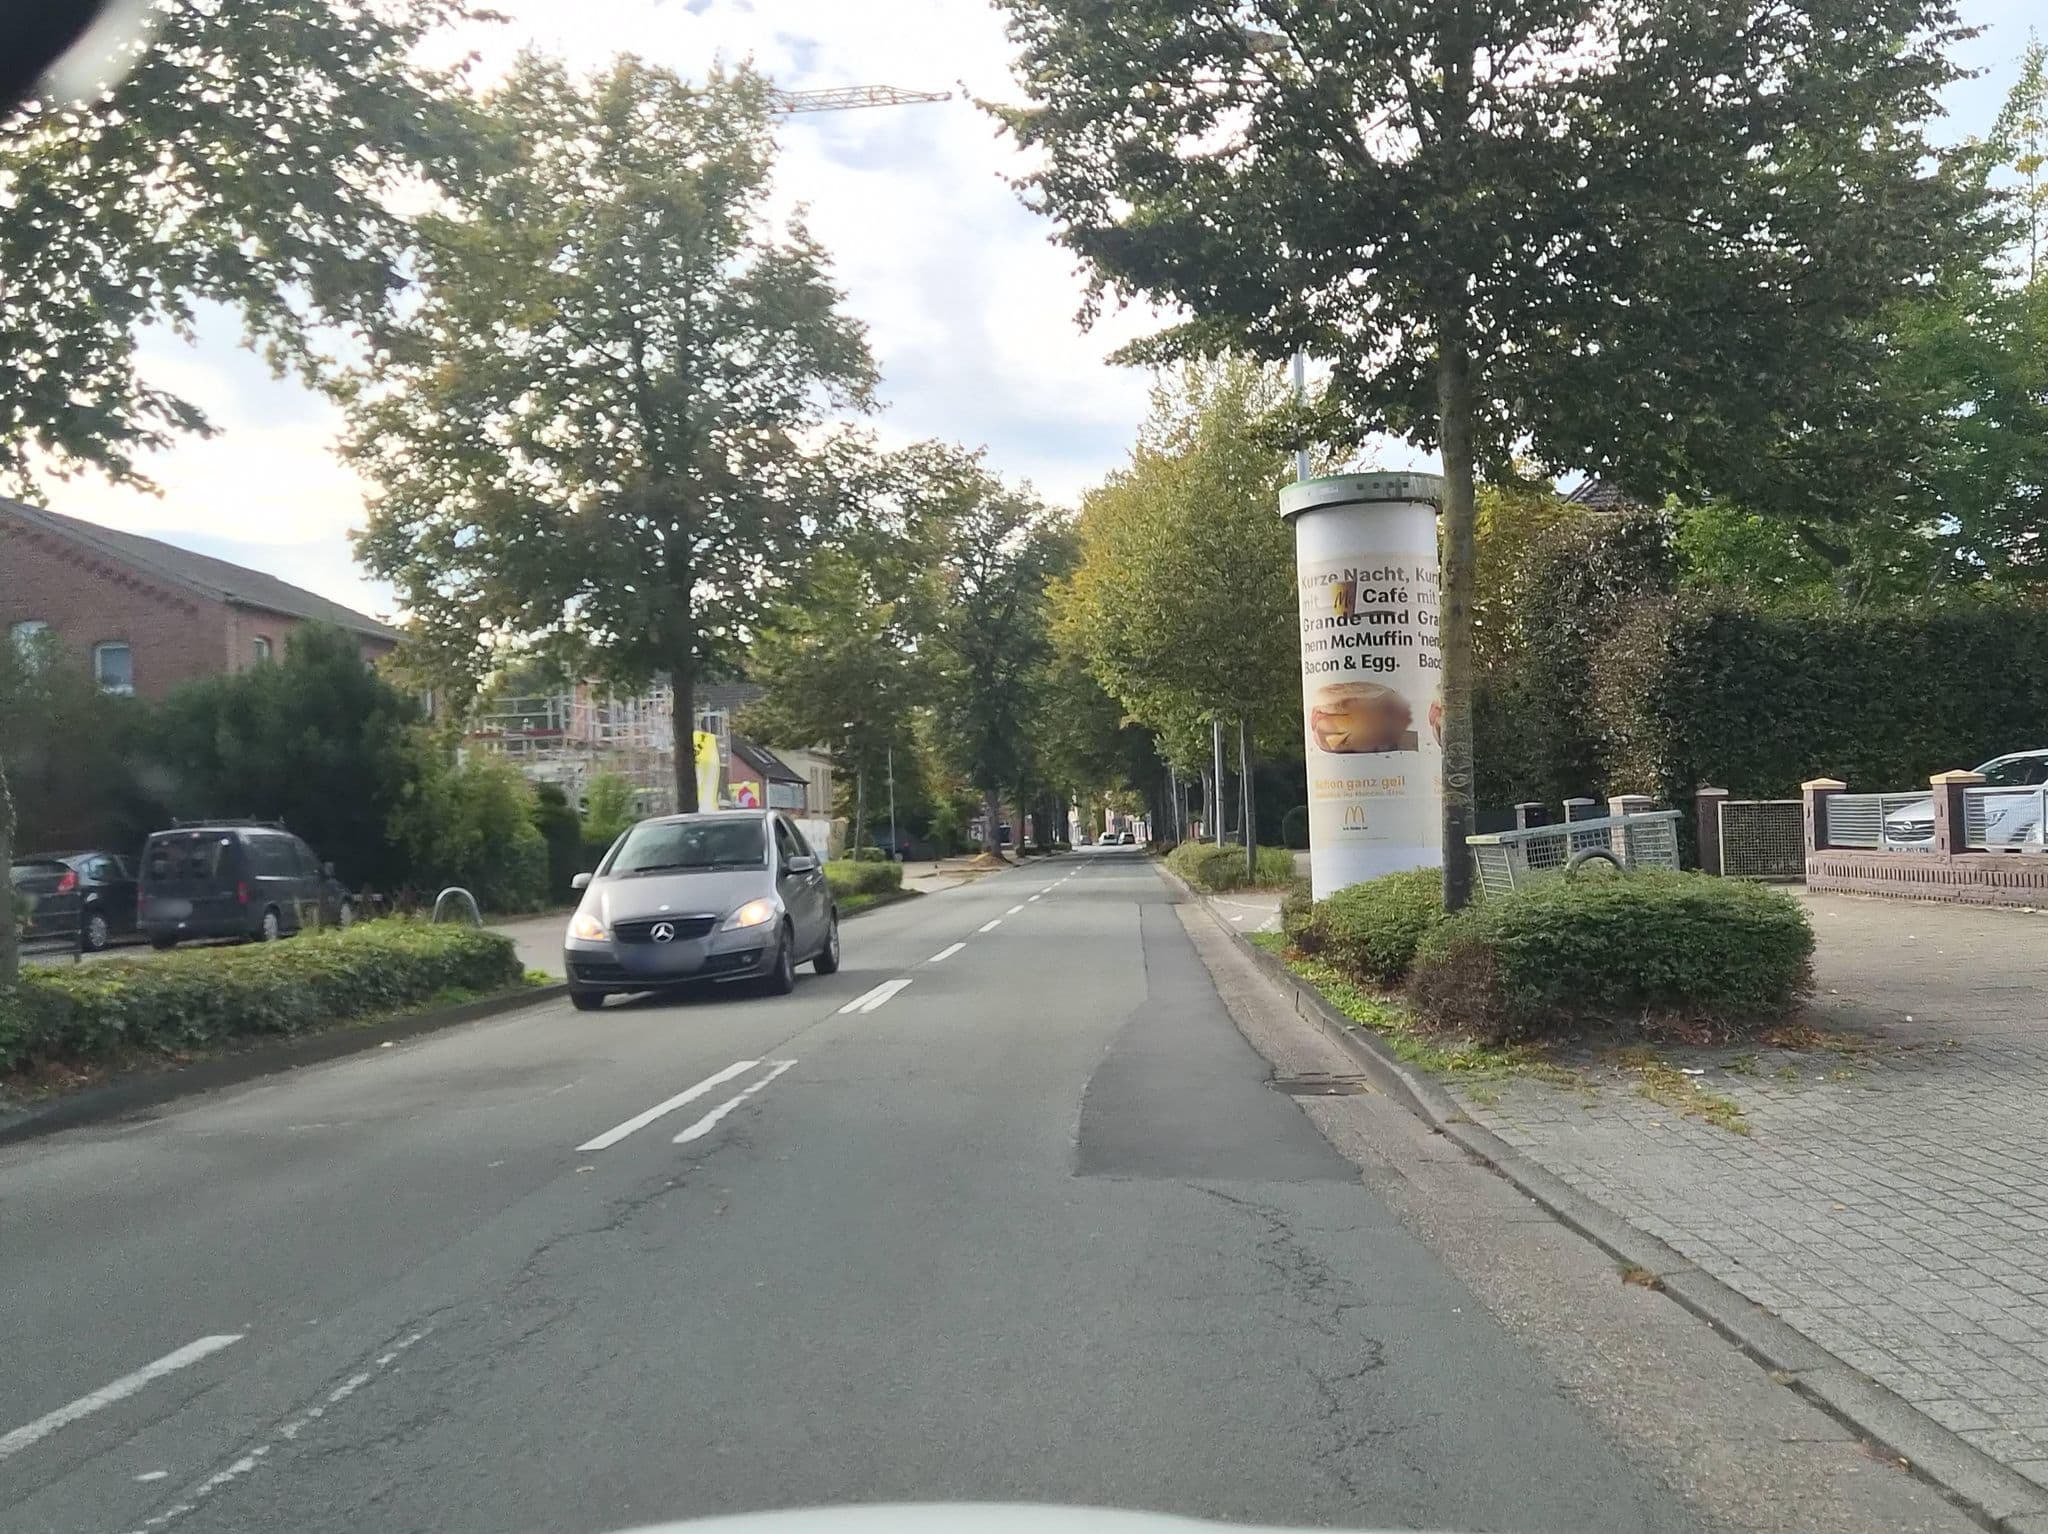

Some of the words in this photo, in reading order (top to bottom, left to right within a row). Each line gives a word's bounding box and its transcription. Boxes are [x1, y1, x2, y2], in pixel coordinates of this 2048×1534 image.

[1344, 566, 1410, 583] Nacht,
[1362, 587, 1408, 603] Café
[1417, 589, 1437, 605] mit
[1304, 611, 1361, 632] Grande
[1369, 609, 1409, 625] und
[1418, 610, 1440, 626] Gra
[1331, 630, 1413, 649] McMuffin
[1304, 658, 1339, 675] Bacon
[1343, 655, 1357, 670] &
[1361, 654, 1401, 672] Egg.
[1346, 778, 1377, 791] ganz
[1381, 775, 1405, 790] geil
